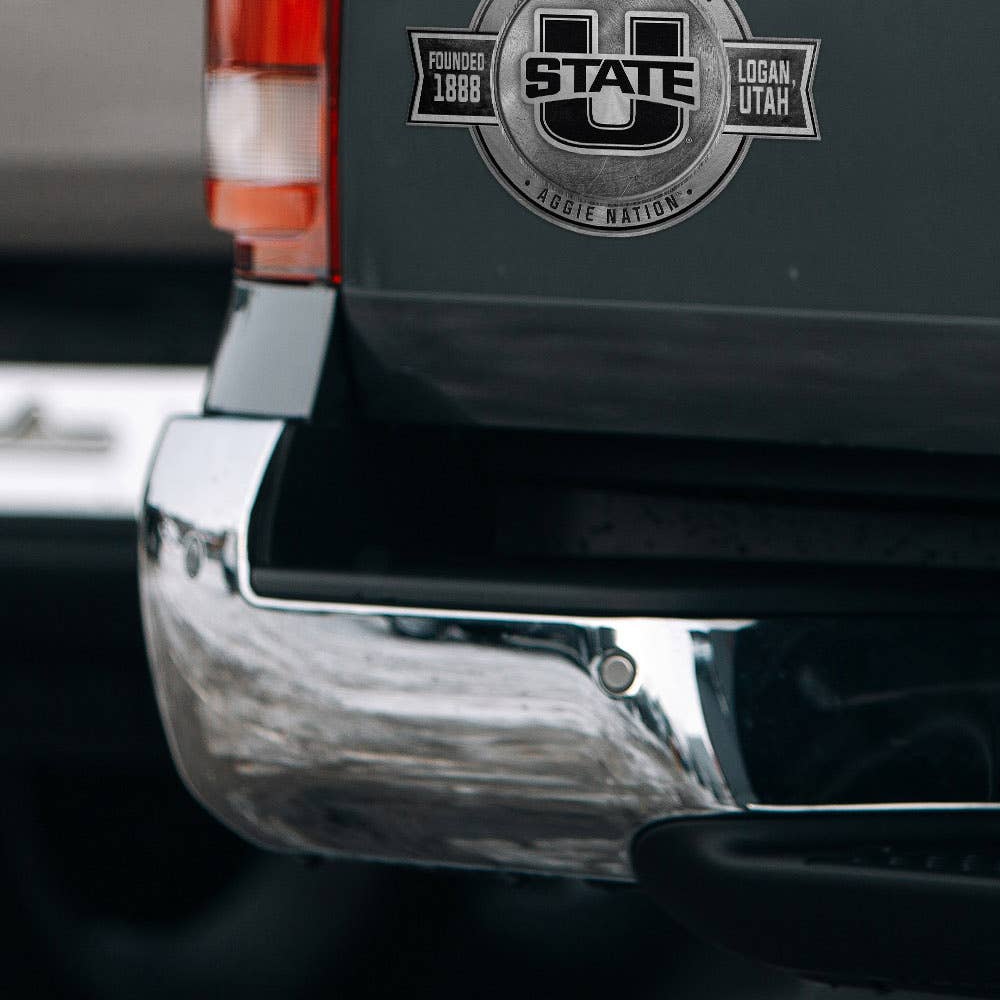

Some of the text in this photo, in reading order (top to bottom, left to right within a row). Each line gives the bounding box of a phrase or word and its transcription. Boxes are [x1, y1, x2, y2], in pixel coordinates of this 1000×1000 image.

[428, 50, 485, 71] FOUNDED
[738, 58, 796, 89] LOGAN,
[433, 73, 481, 103] 1888
[525, 57, 695, 106] STATE
[739, 85, 789, 116] UTAH
[536, 188, 680, 224] AGGIE NATION
